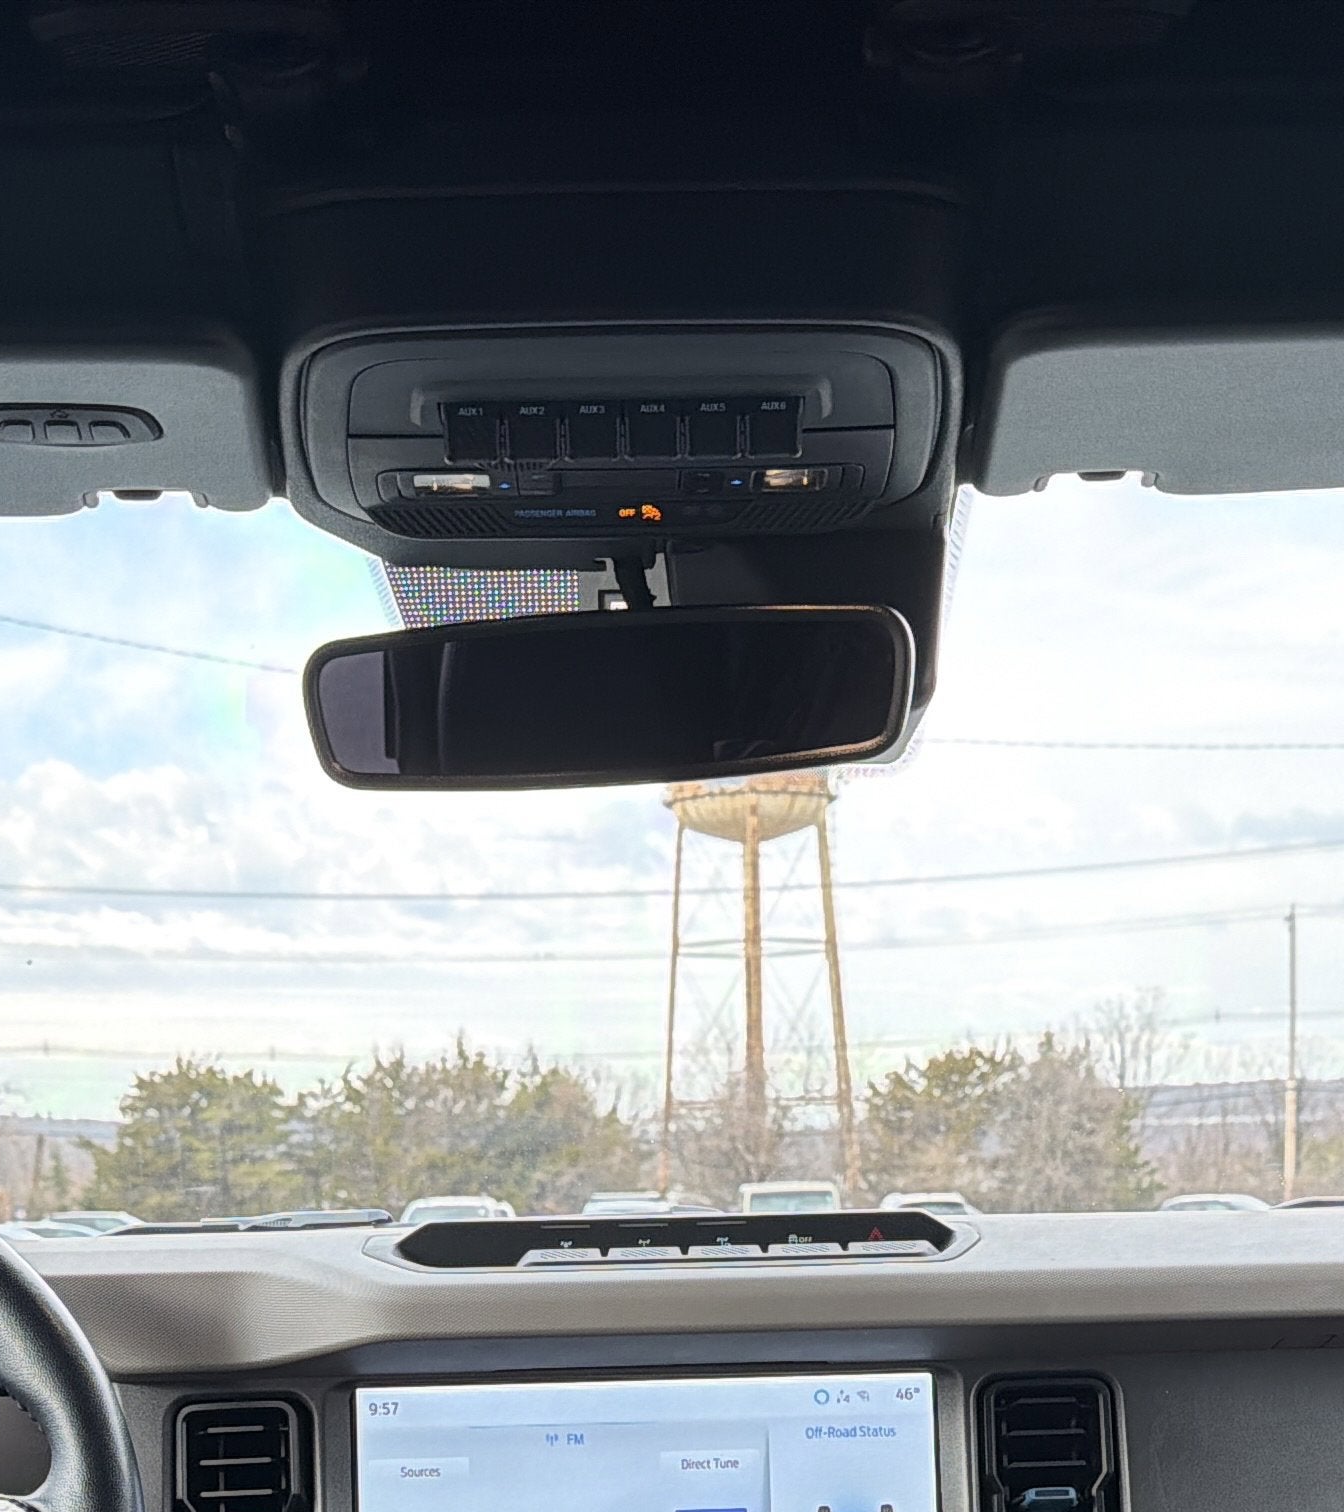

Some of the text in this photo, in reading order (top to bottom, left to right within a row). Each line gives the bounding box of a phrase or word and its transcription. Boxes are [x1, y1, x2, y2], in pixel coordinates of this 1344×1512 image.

[514, 508, 636, 518] PASSENGER AIRBAG OFF
[369, 1403, 399, 1417] 9:57
[805, 1425, 896, 1439] Off-Road Status
[567, 1434, 585, 1446] FM
[681, 1456, 740, 1471] Direct Tune
[400, 1465, 441, 1480] Sources
